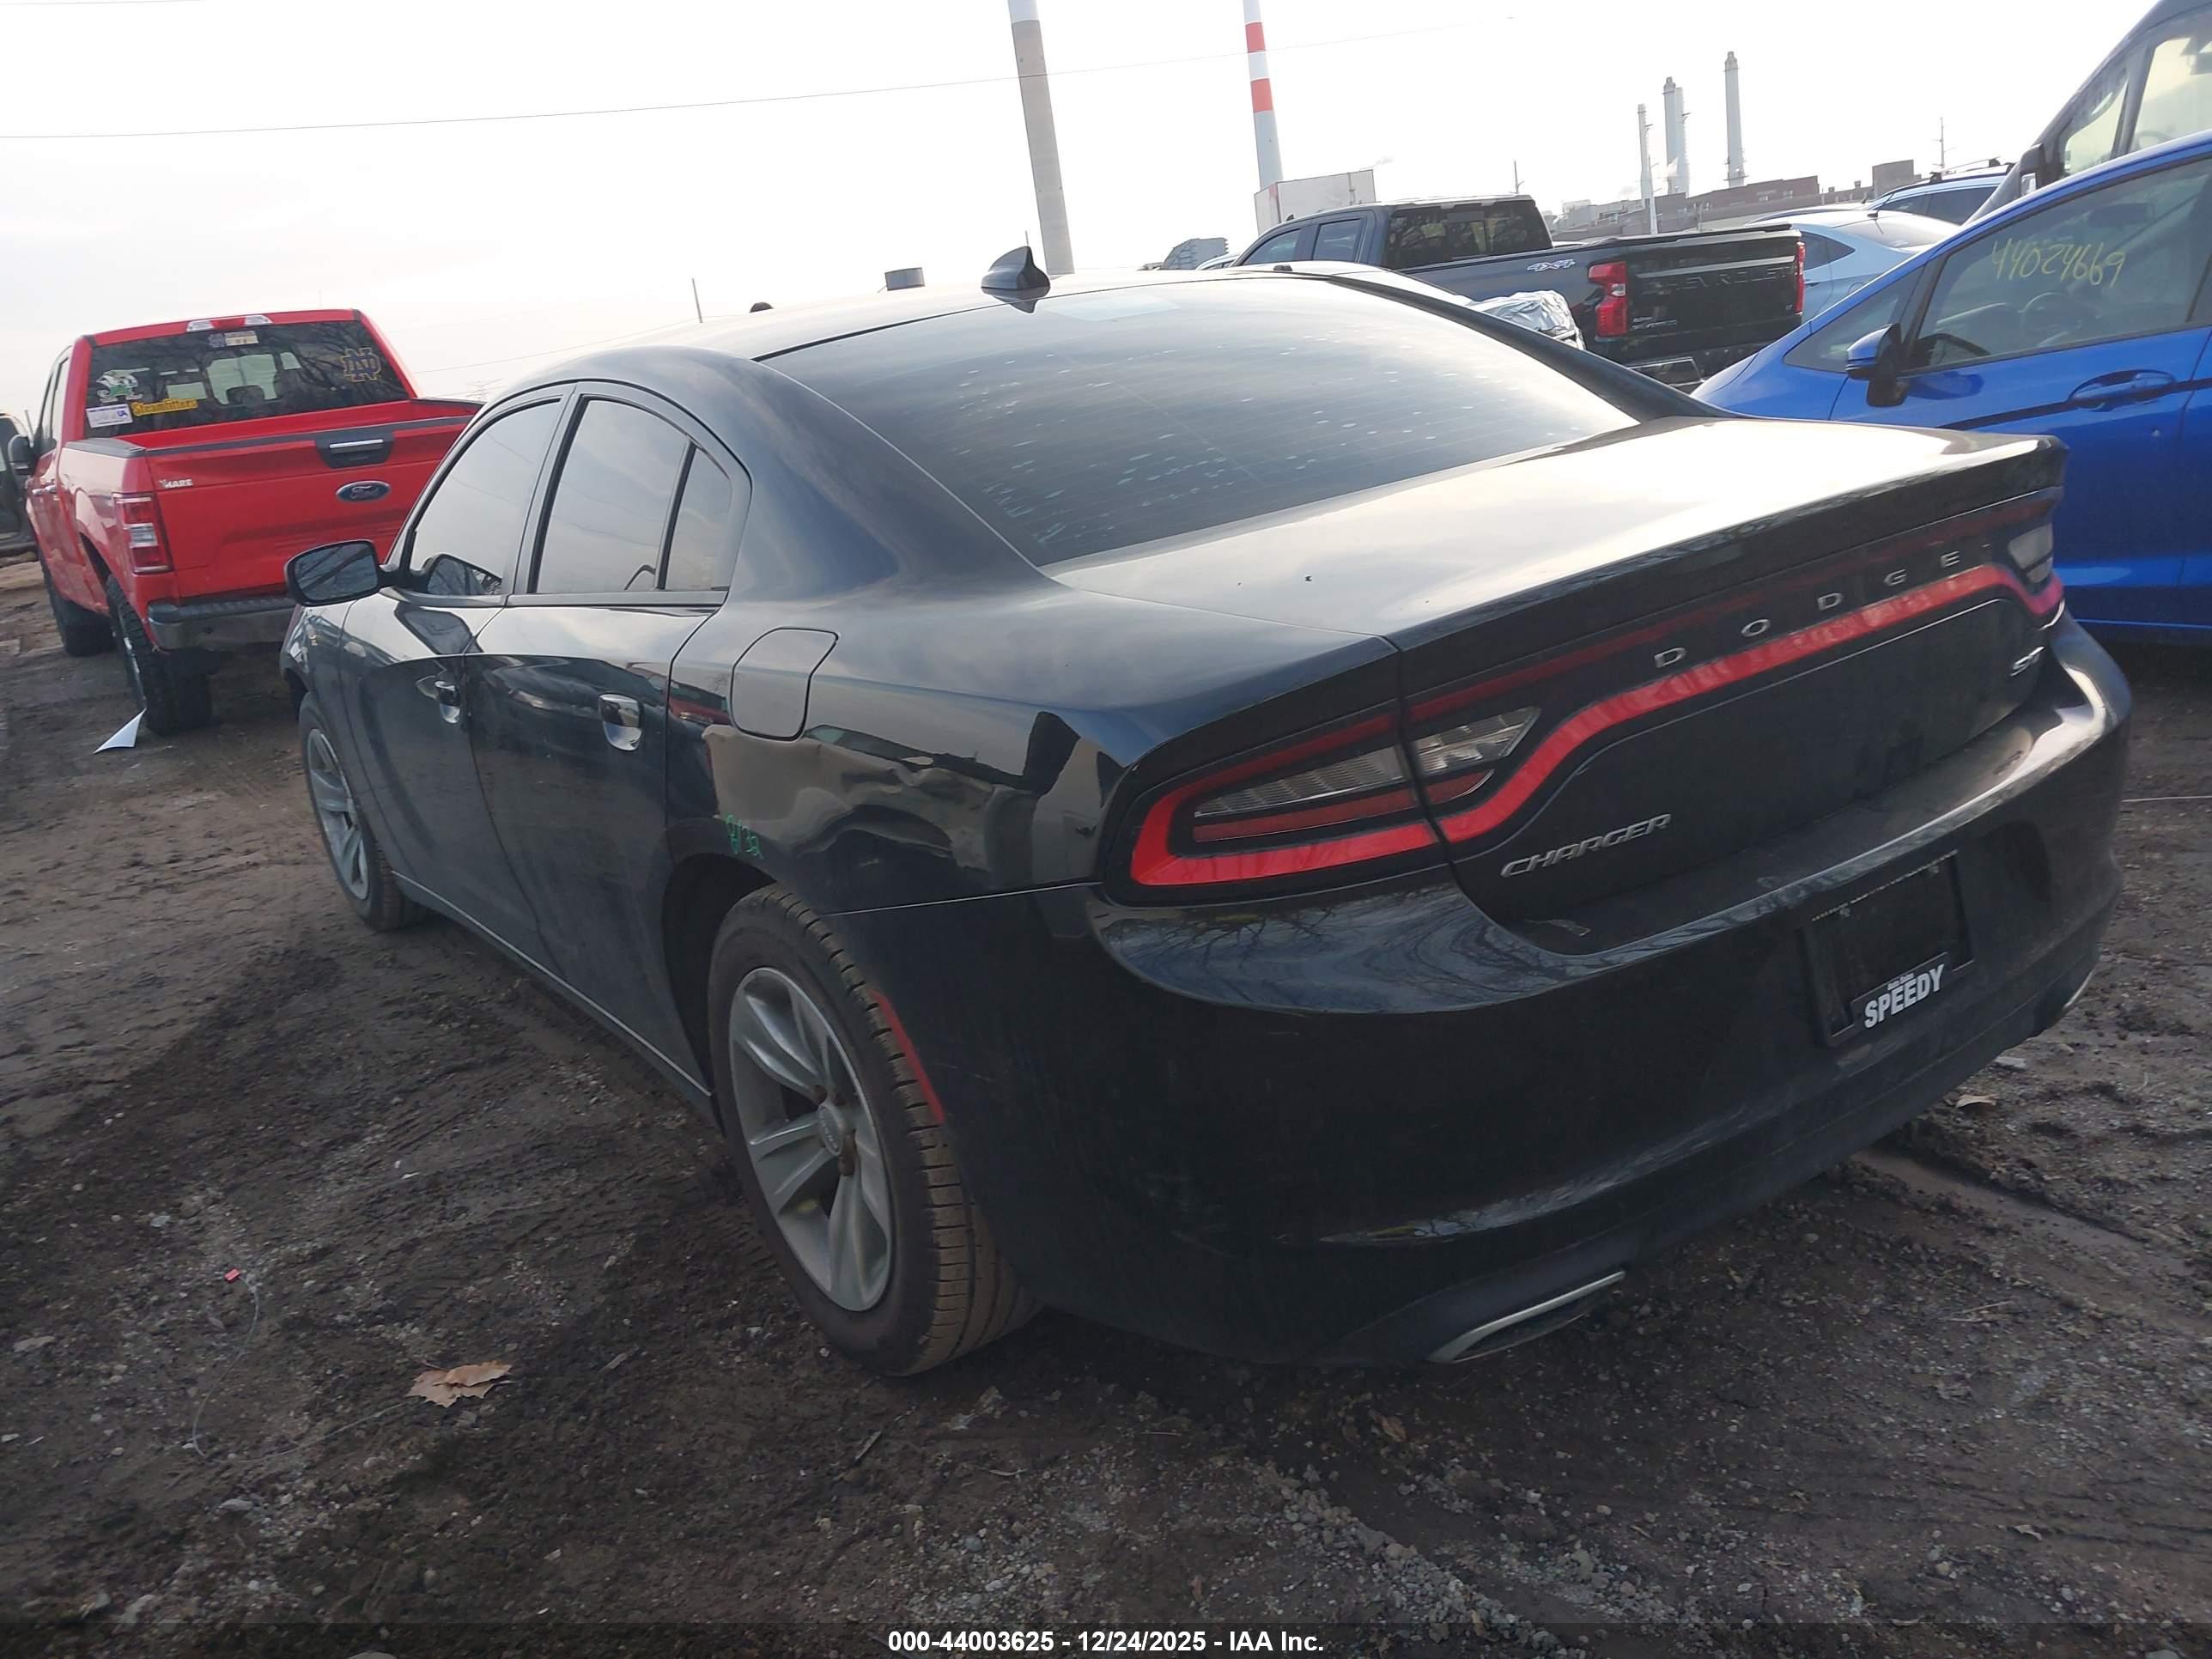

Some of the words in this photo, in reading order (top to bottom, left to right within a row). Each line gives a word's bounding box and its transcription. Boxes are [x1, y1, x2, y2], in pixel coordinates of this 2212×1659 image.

[1991, 237, 2125, 289] 44024669
[1655, 550, 1960, 668] DODGE
[1500, 813, 1671, 878] CHARGER
[1864, 963, 1945, 1029] SPEEDY
